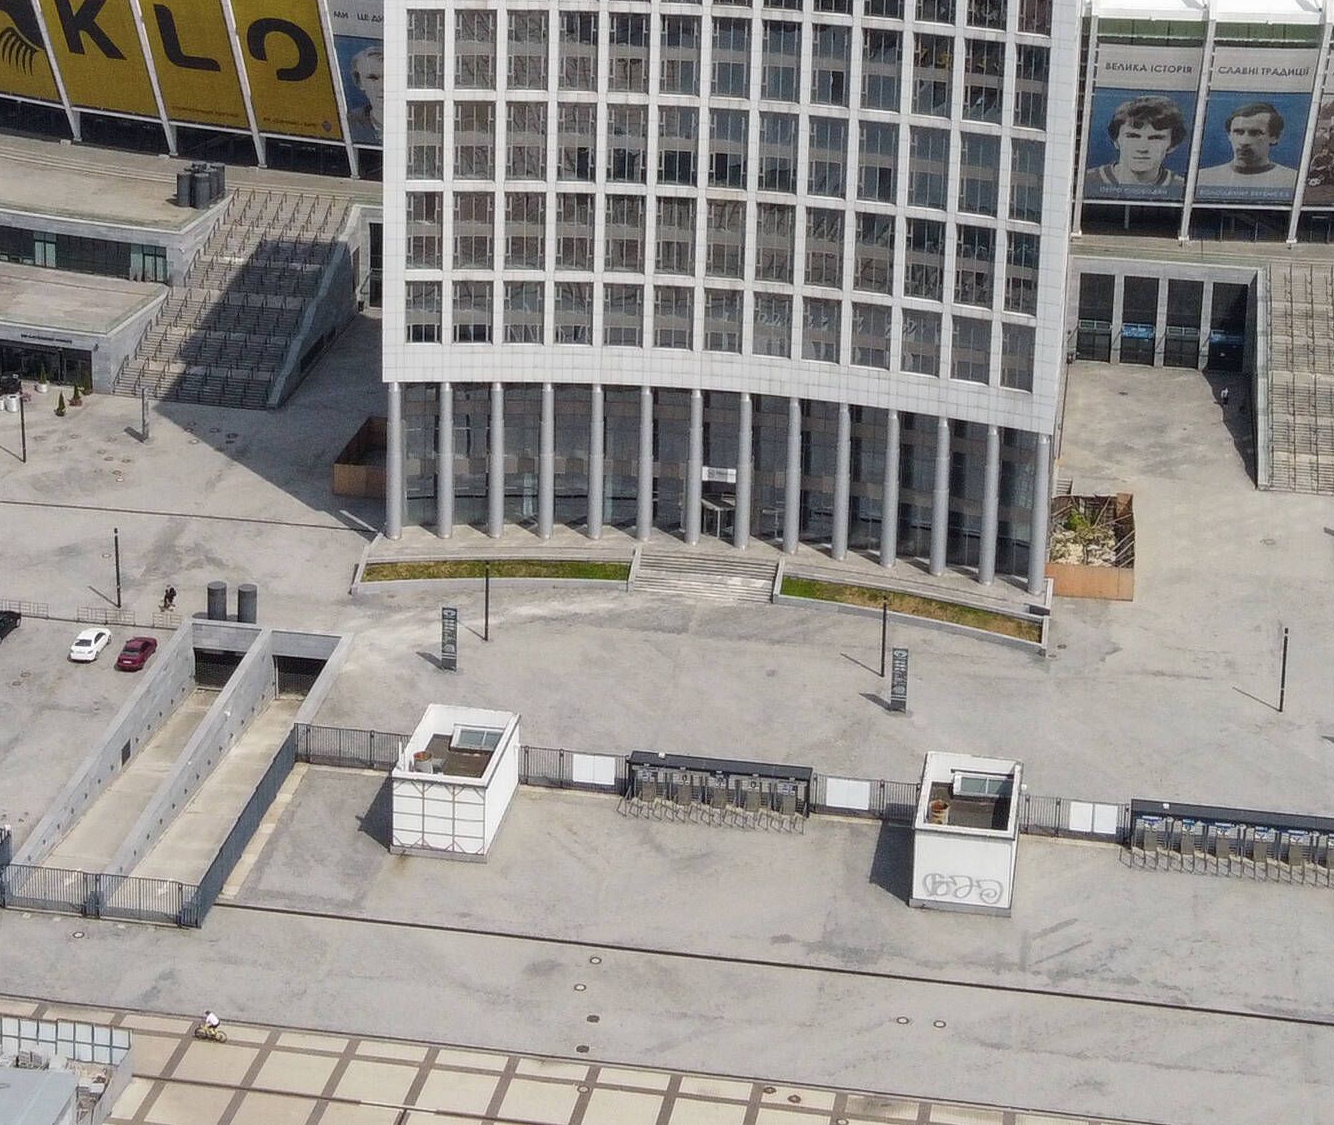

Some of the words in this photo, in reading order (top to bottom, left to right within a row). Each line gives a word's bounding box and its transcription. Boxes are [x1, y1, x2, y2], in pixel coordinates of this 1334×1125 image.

[1105, 62, 1147, 73] ВЕЛИКА
[1151, 64, 1193, 74] ІСТОРІЯ
[1218, 66, 1259, 76] СЛАВНІ
